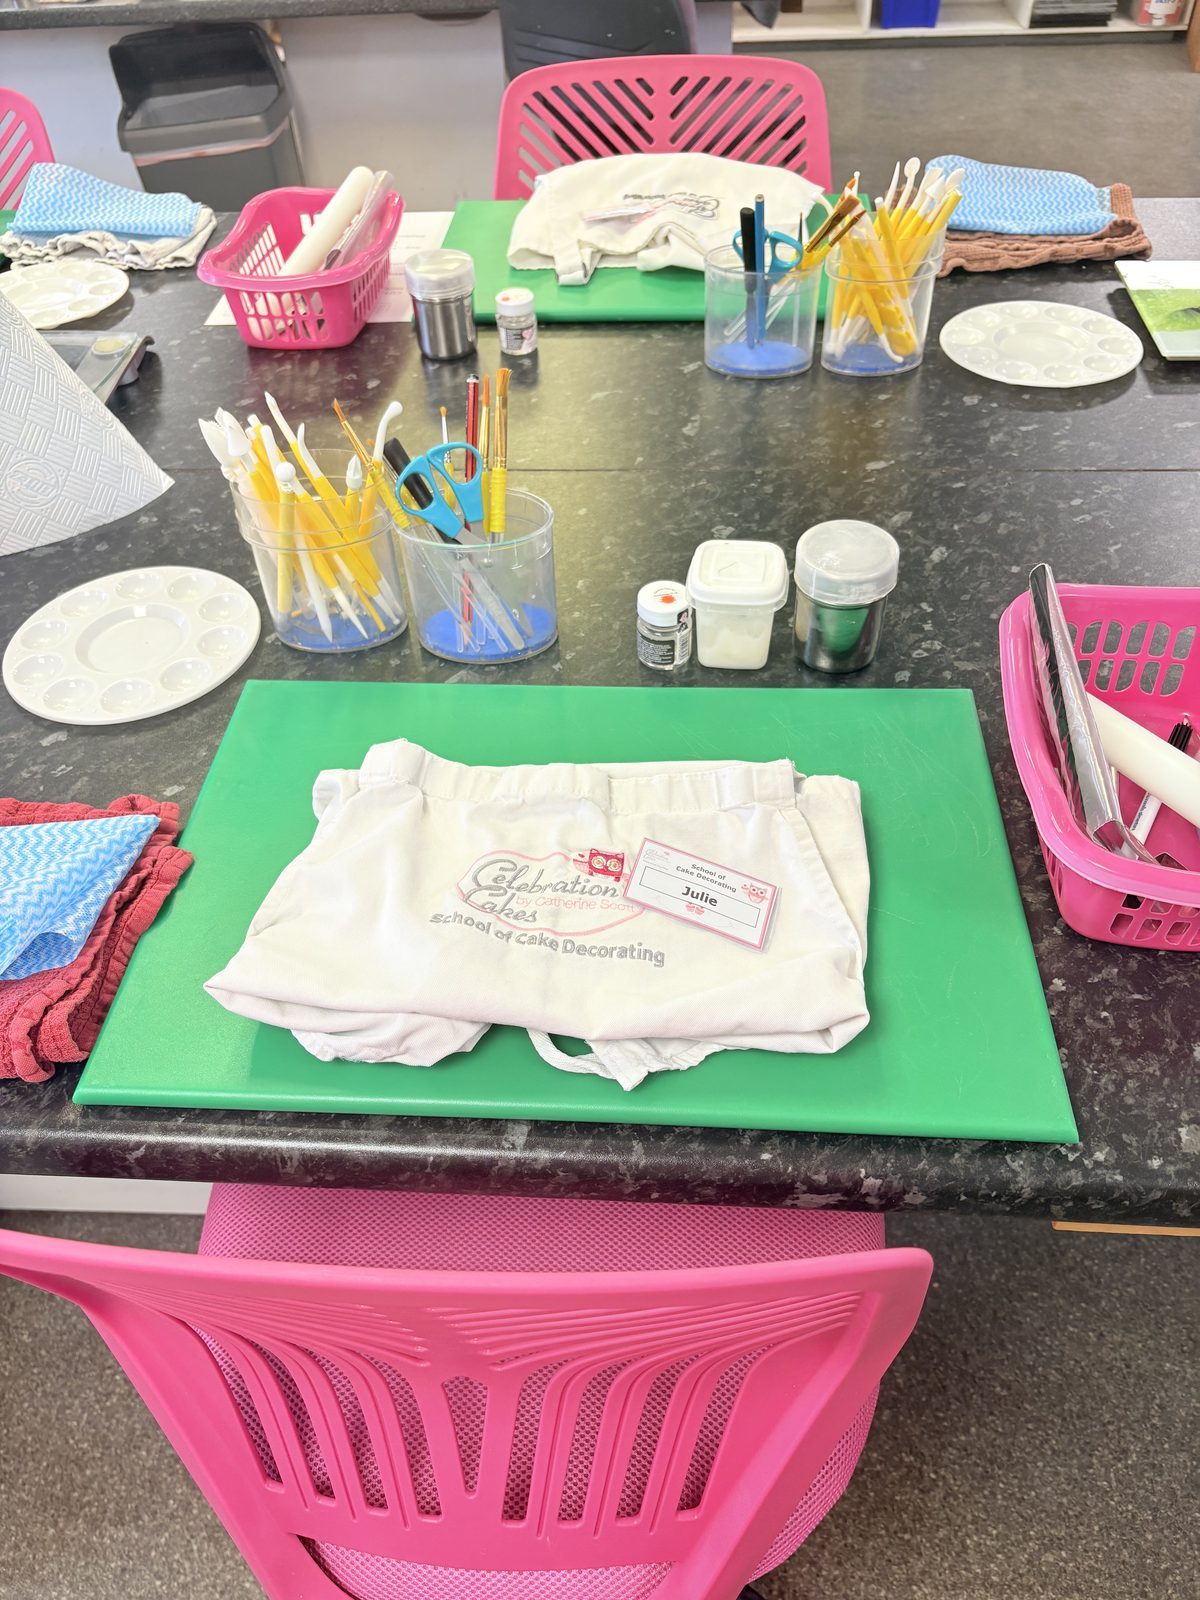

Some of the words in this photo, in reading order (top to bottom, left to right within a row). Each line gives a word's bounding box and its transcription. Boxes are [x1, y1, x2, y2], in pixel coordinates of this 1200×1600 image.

[472, 859, 619, 898] Celebration
[676, 865, 695, 876] Cake
[696, 872, 737, 893] Decorating
[691, 864, 717, 877] School
[464, 885, 538, 923] Cakes
[516, 896, 532, 907] by
[535, 896, 597, 910] Catherine
[600, 899, 636, 912] Scott
[681, 886, 718, 907] Julie
[494, 929, 514, 943] of
[562, 938, 665, 968] Decorating
